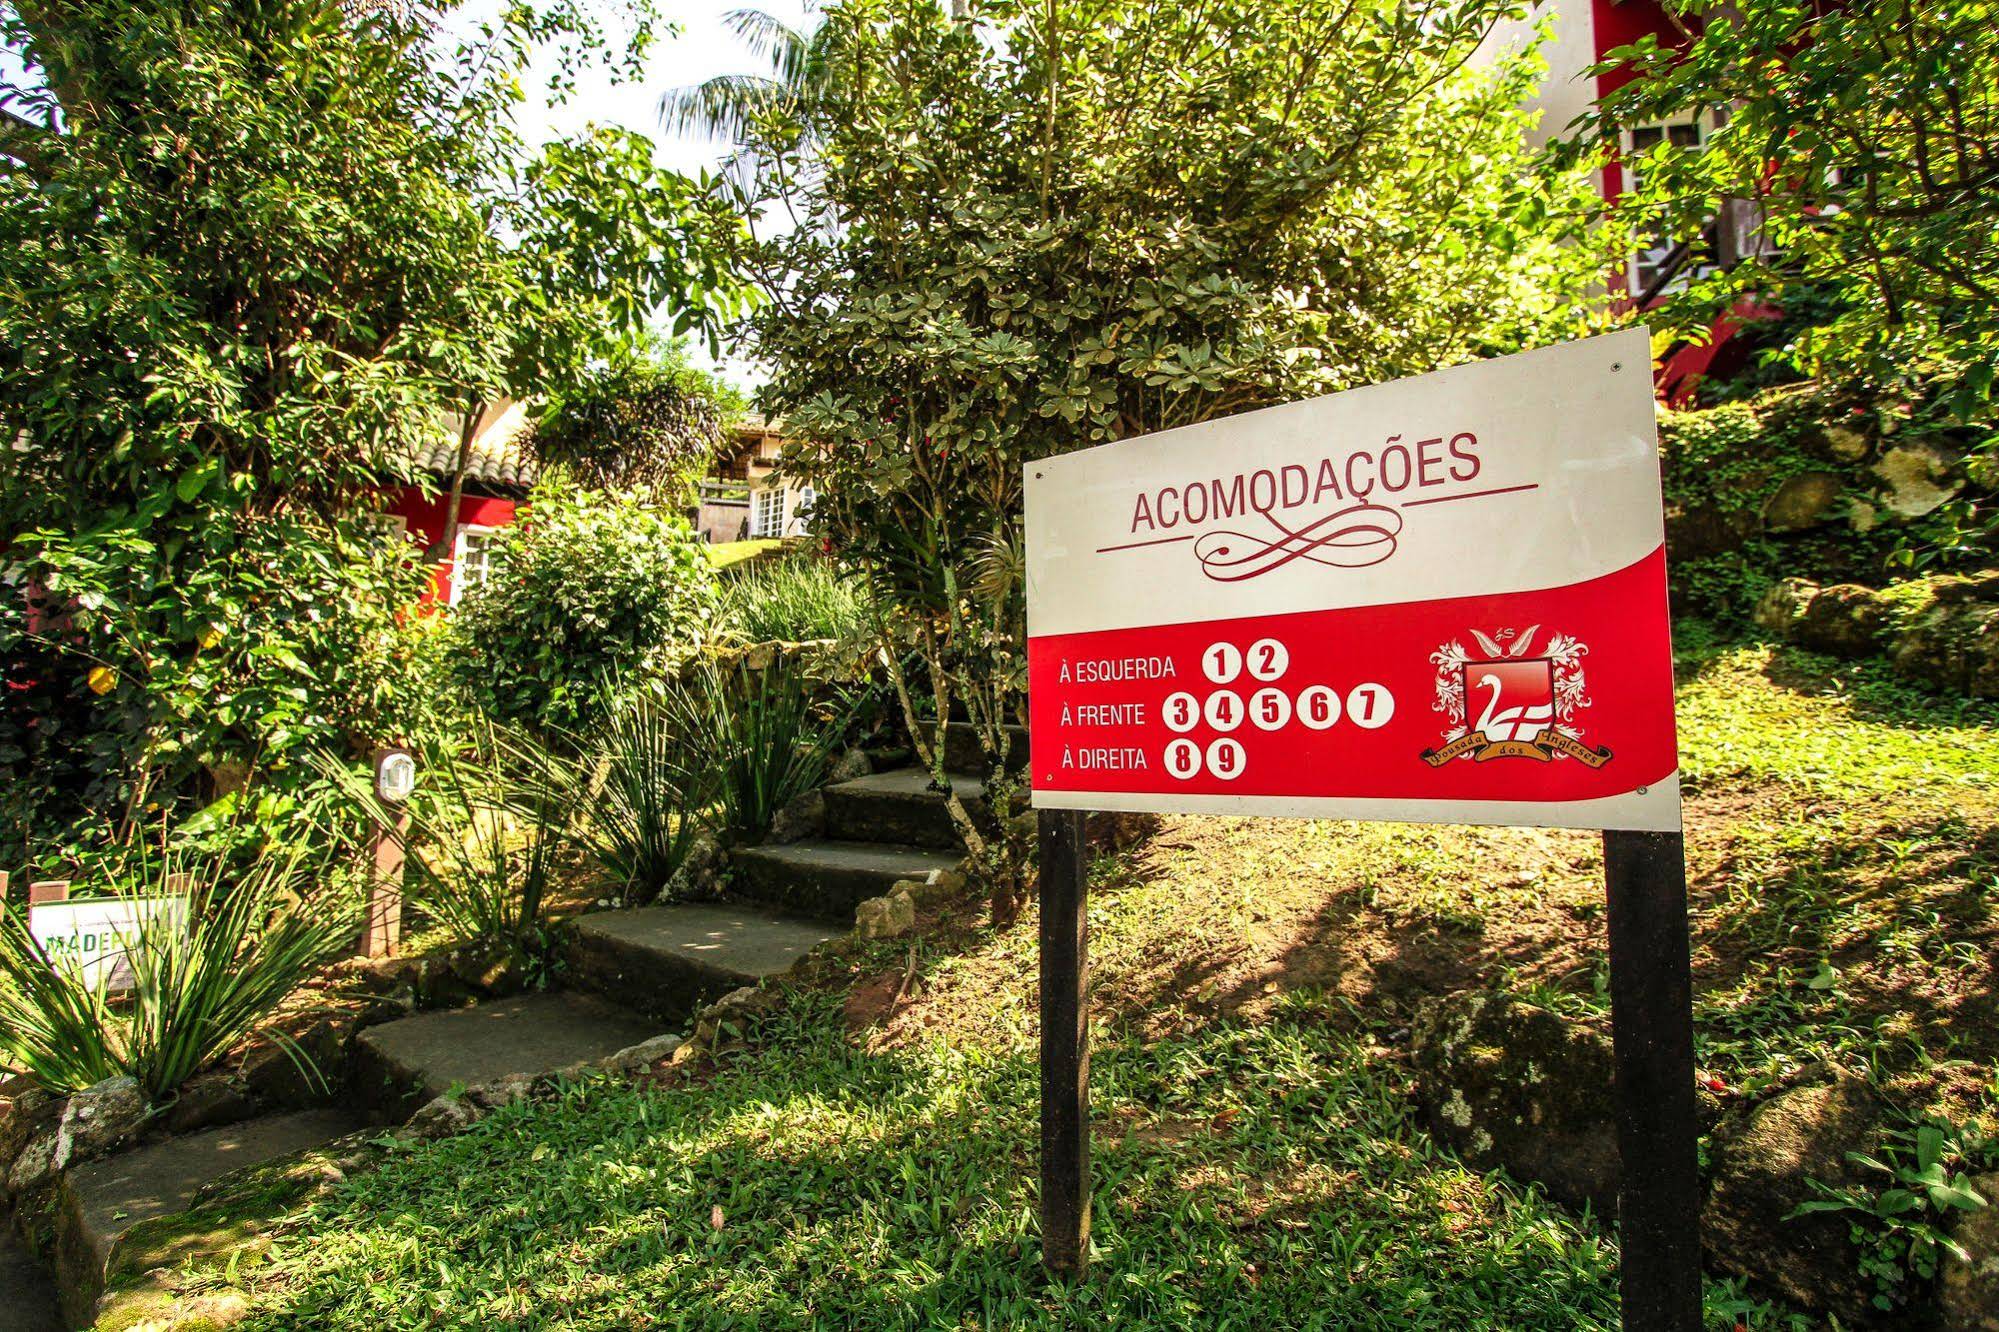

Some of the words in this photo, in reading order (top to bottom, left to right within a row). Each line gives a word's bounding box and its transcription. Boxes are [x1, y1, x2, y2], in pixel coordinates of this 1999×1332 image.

[1131, 431, 1482, 534] ACOMODAÇÕES
[1059, 658, 1072, 683] À
[1076, 656, 1176, 683] ESQUERDA
[1060, 702, 1073, 727] À
[1077, 703, 1145, 726] FRENTE
[1061, 744, 1074, 769] À
[1078, 748, 1148, 769] DIREITA
[1431, 735, 1482, 762] Pousada
[1499, 745, 1524, 755] dos
[1541, 732, 1598, 764] Ingleses
